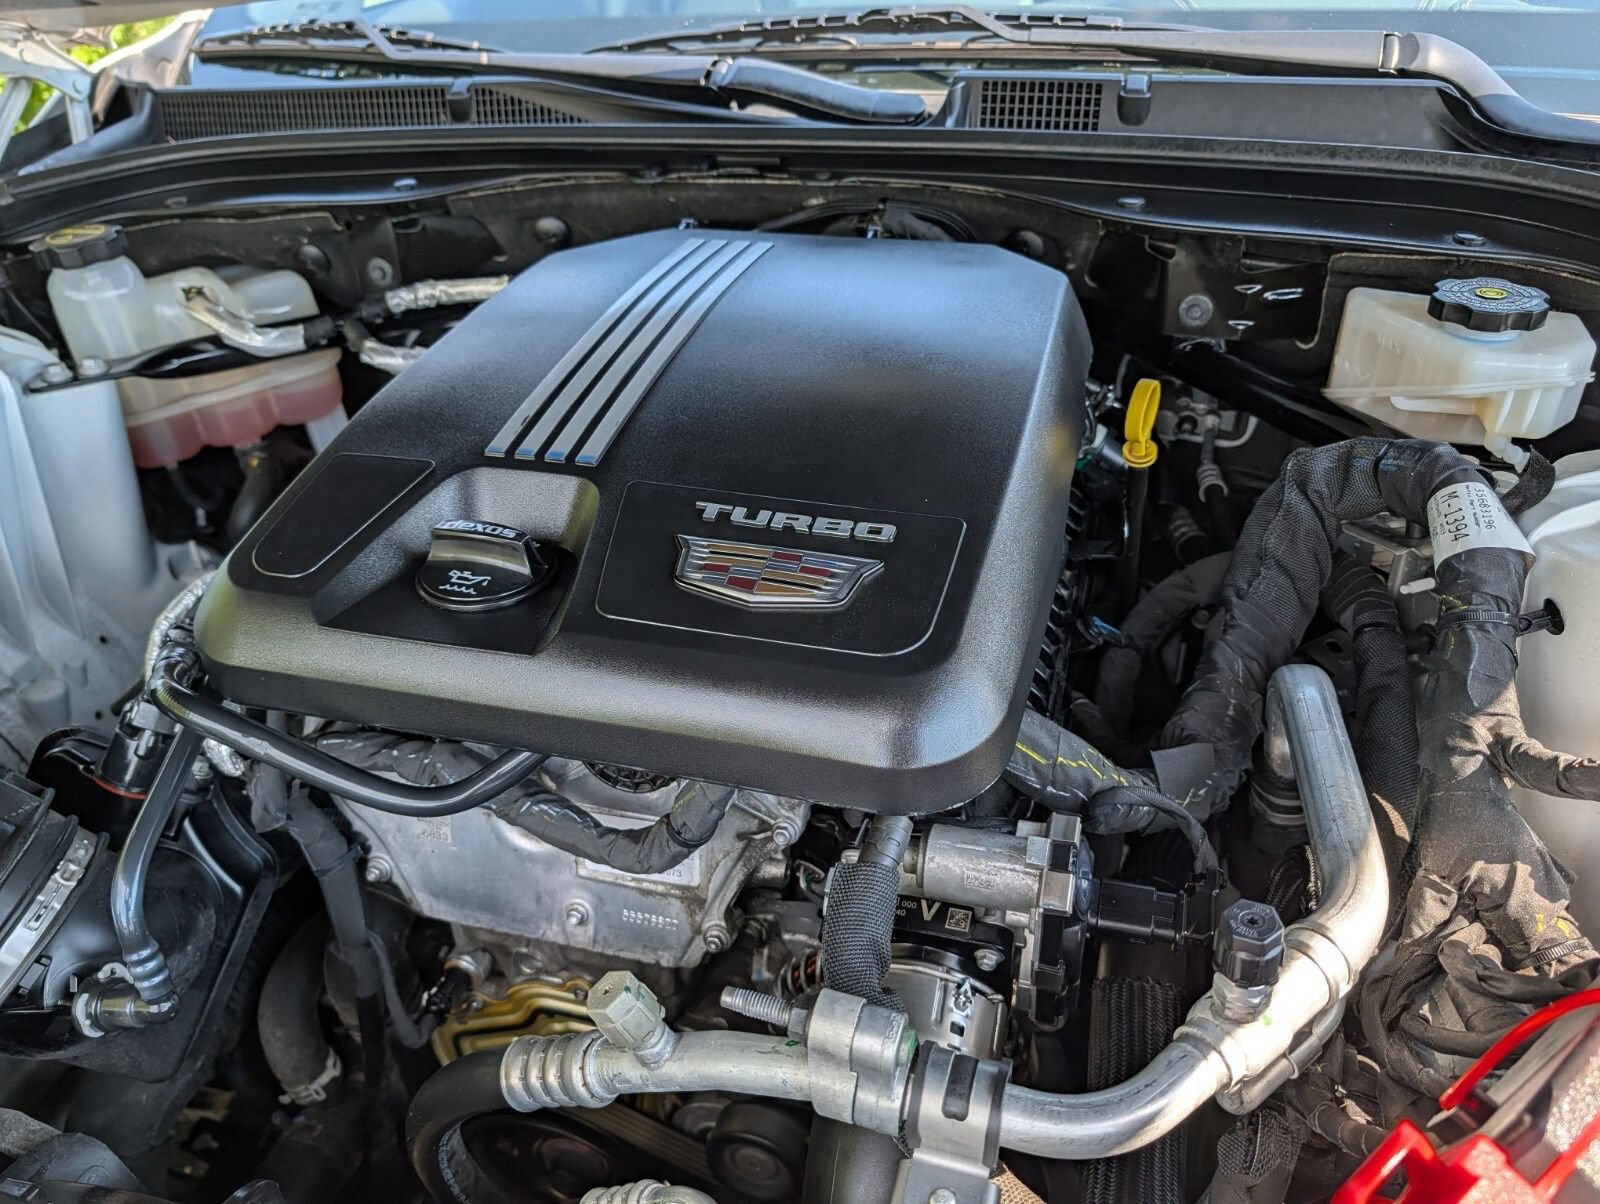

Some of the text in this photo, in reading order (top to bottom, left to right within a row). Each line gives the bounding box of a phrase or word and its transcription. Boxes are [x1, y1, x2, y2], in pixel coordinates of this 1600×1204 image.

[440, 519, 519, 538] dexos
[696, 501, 897, 543] TURBO
[1440, 491, 1470, 542] M-1394
[921, 899, 941, 921] V
